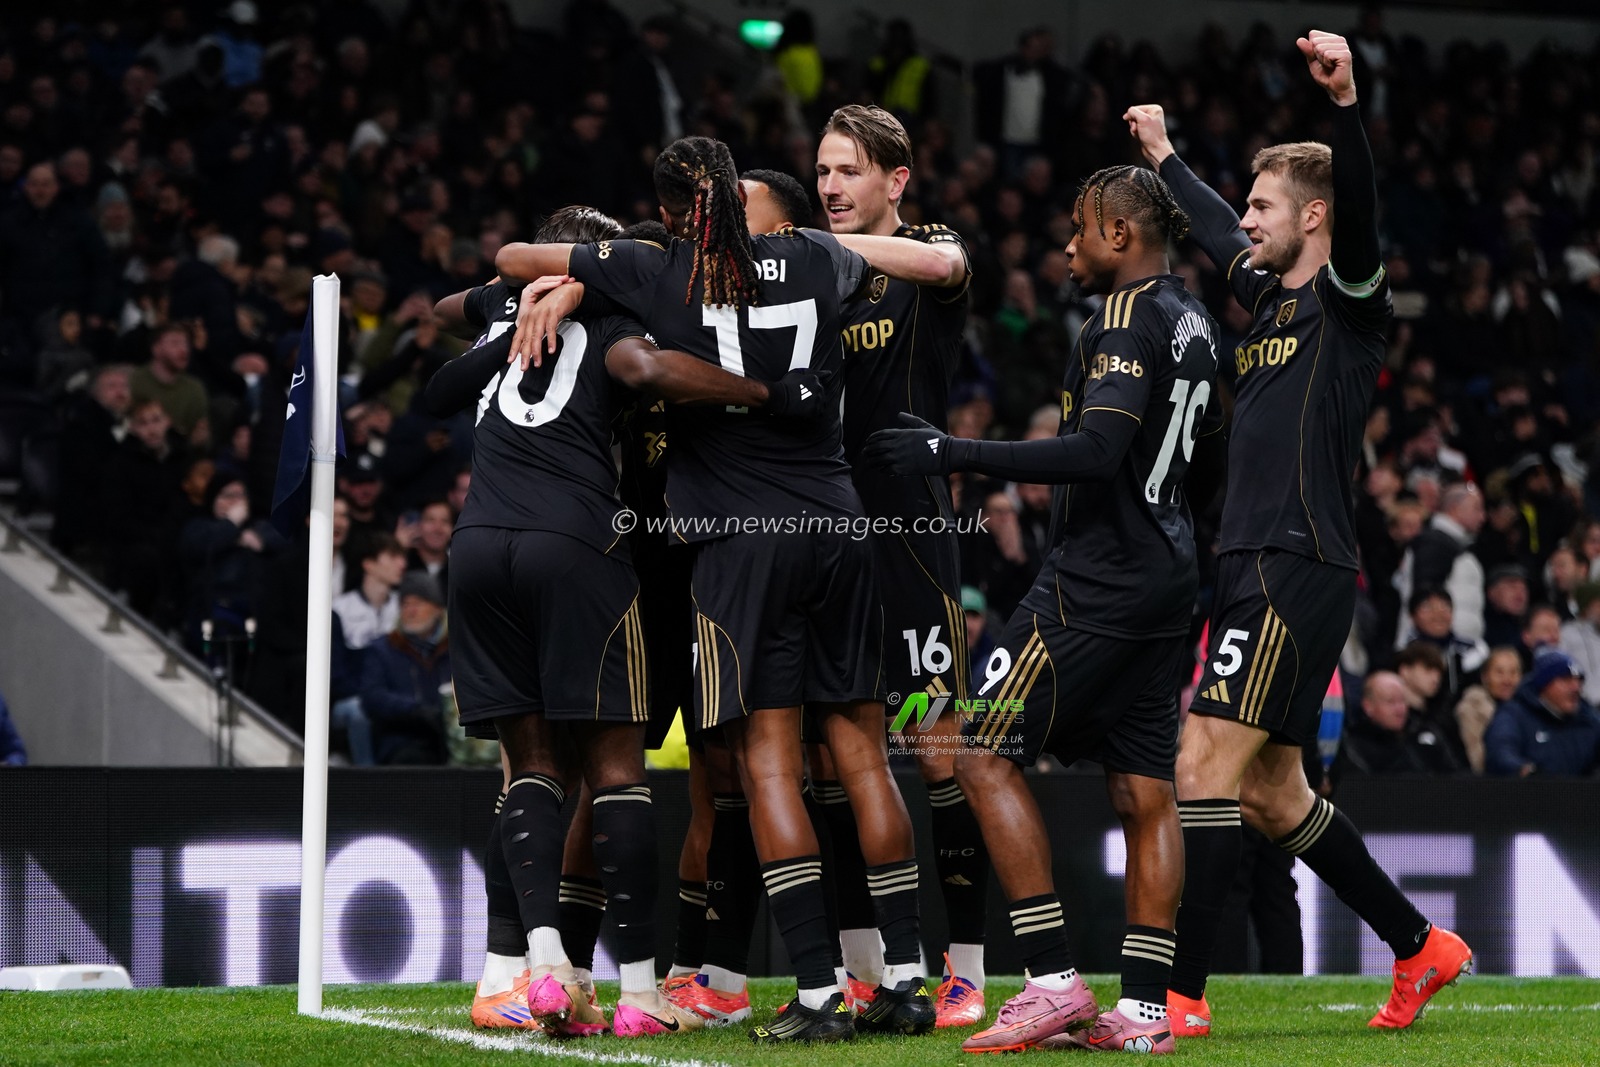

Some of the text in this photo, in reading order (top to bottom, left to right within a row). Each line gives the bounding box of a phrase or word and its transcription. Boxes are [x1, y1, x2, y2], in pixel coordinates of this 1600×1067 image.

[702, 298, 817, 414] 17
[902, 625, 952, 677] 16
[1212, 628, 1250, 677] 5
